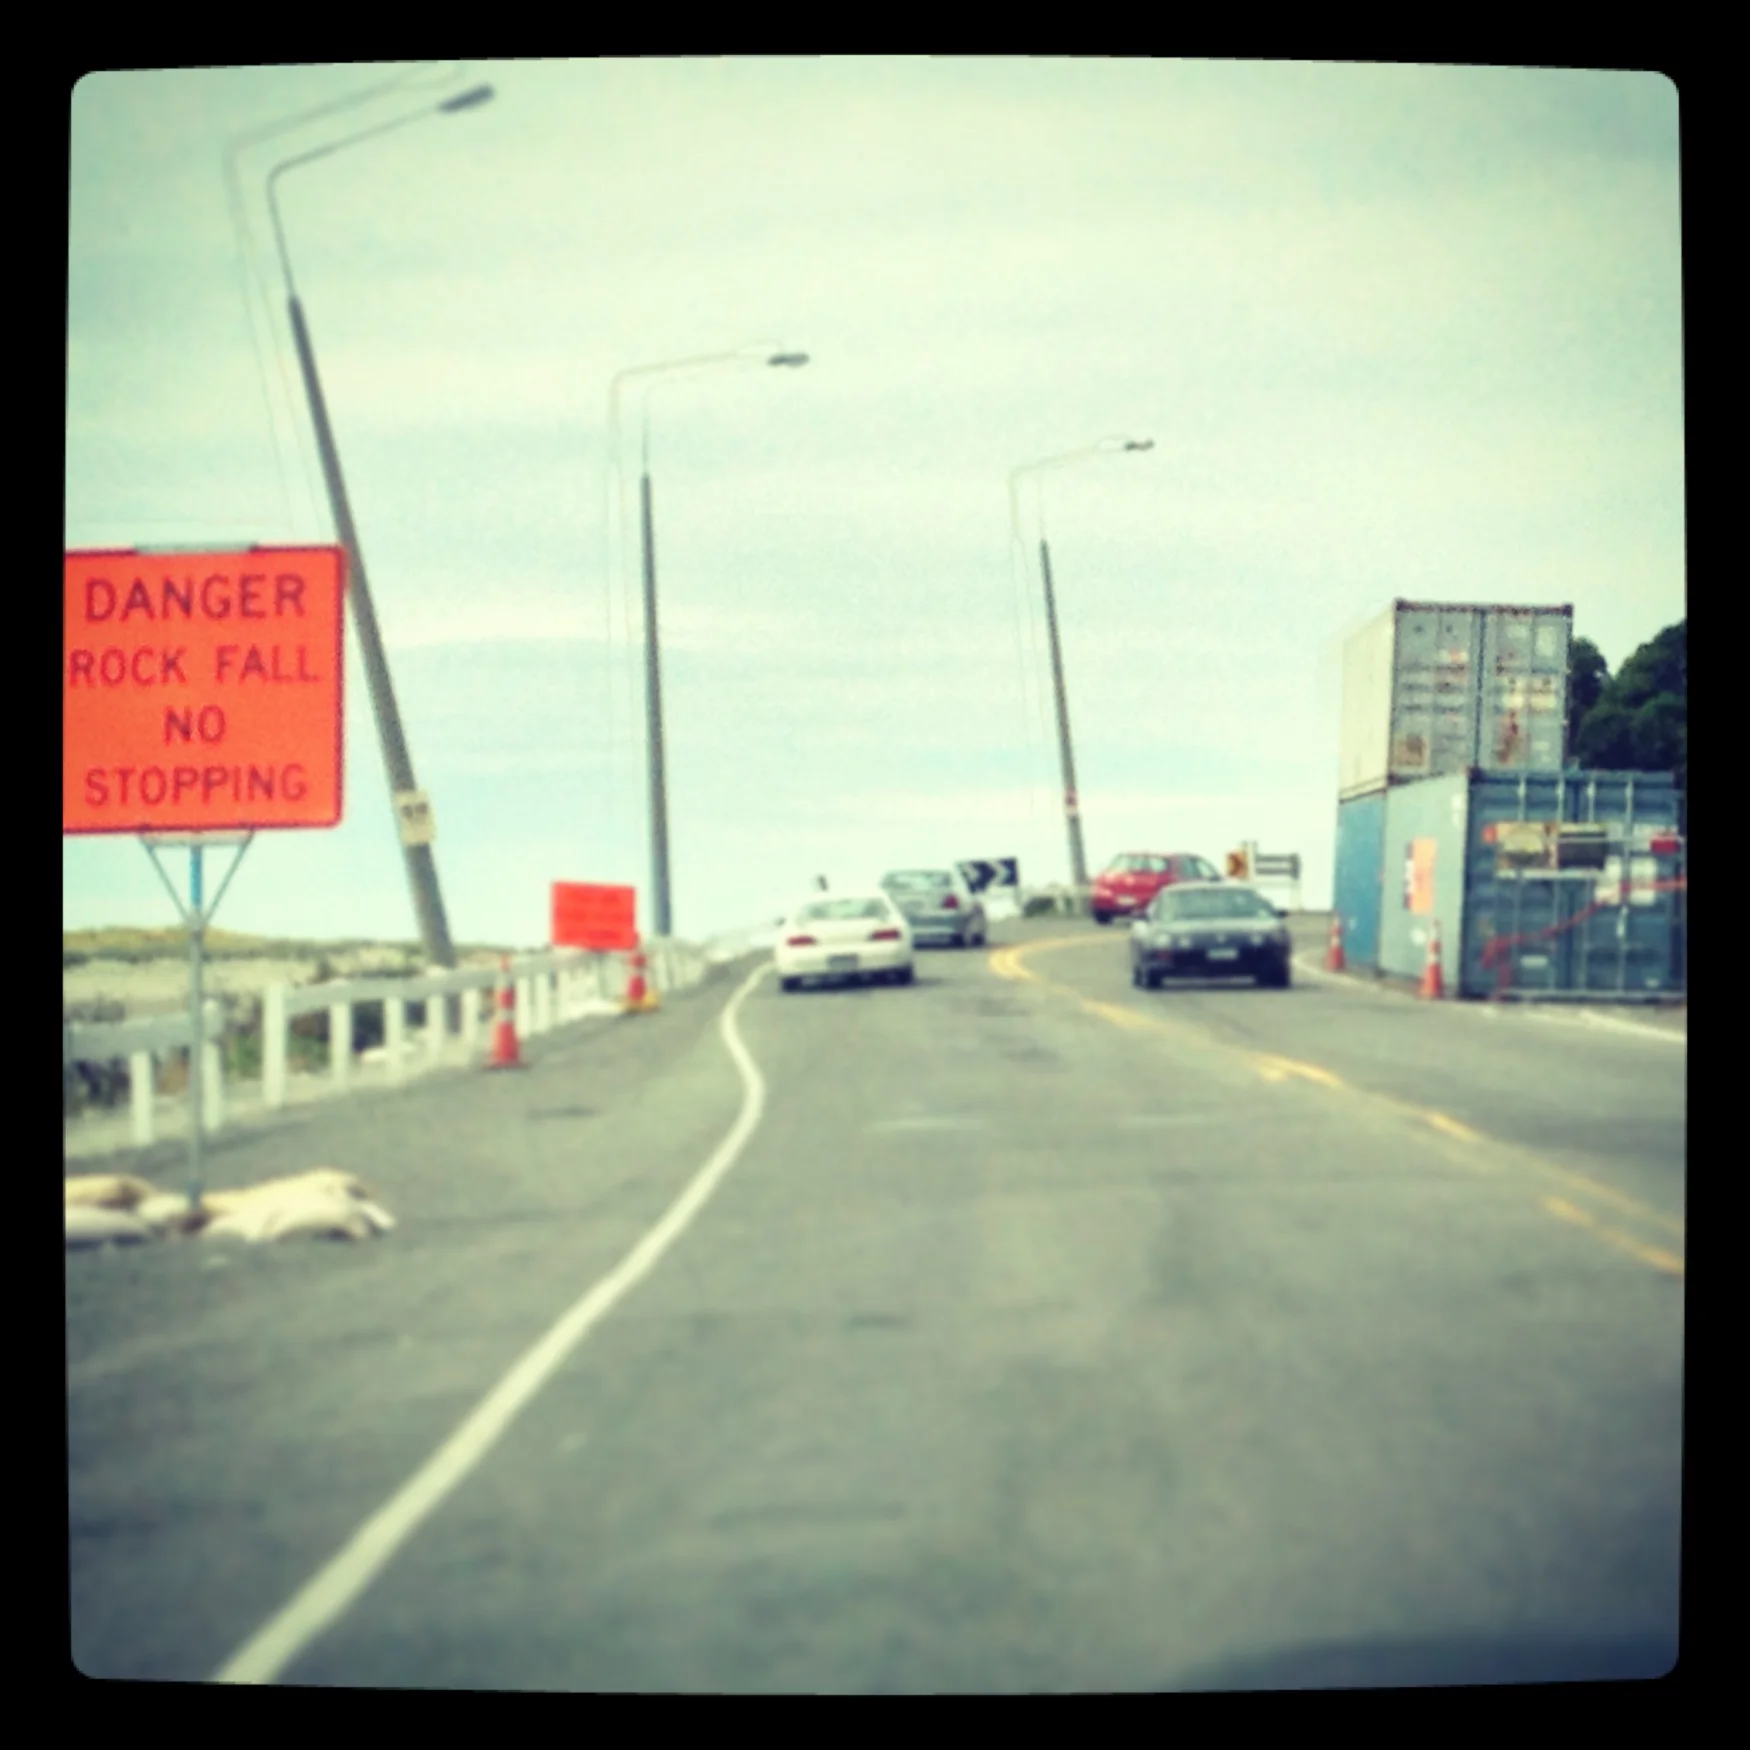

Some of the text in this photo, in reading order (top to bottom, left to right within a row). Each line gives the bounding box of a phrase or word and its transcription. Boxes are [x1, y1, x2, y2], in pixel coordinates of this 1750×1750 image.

[85, 573, 306, 622] DANGER
[69, 644, 319, 688] ROCK FALL
[163, 704, 226, 745] NO
[84, 763, 307, 806] STOPPING
